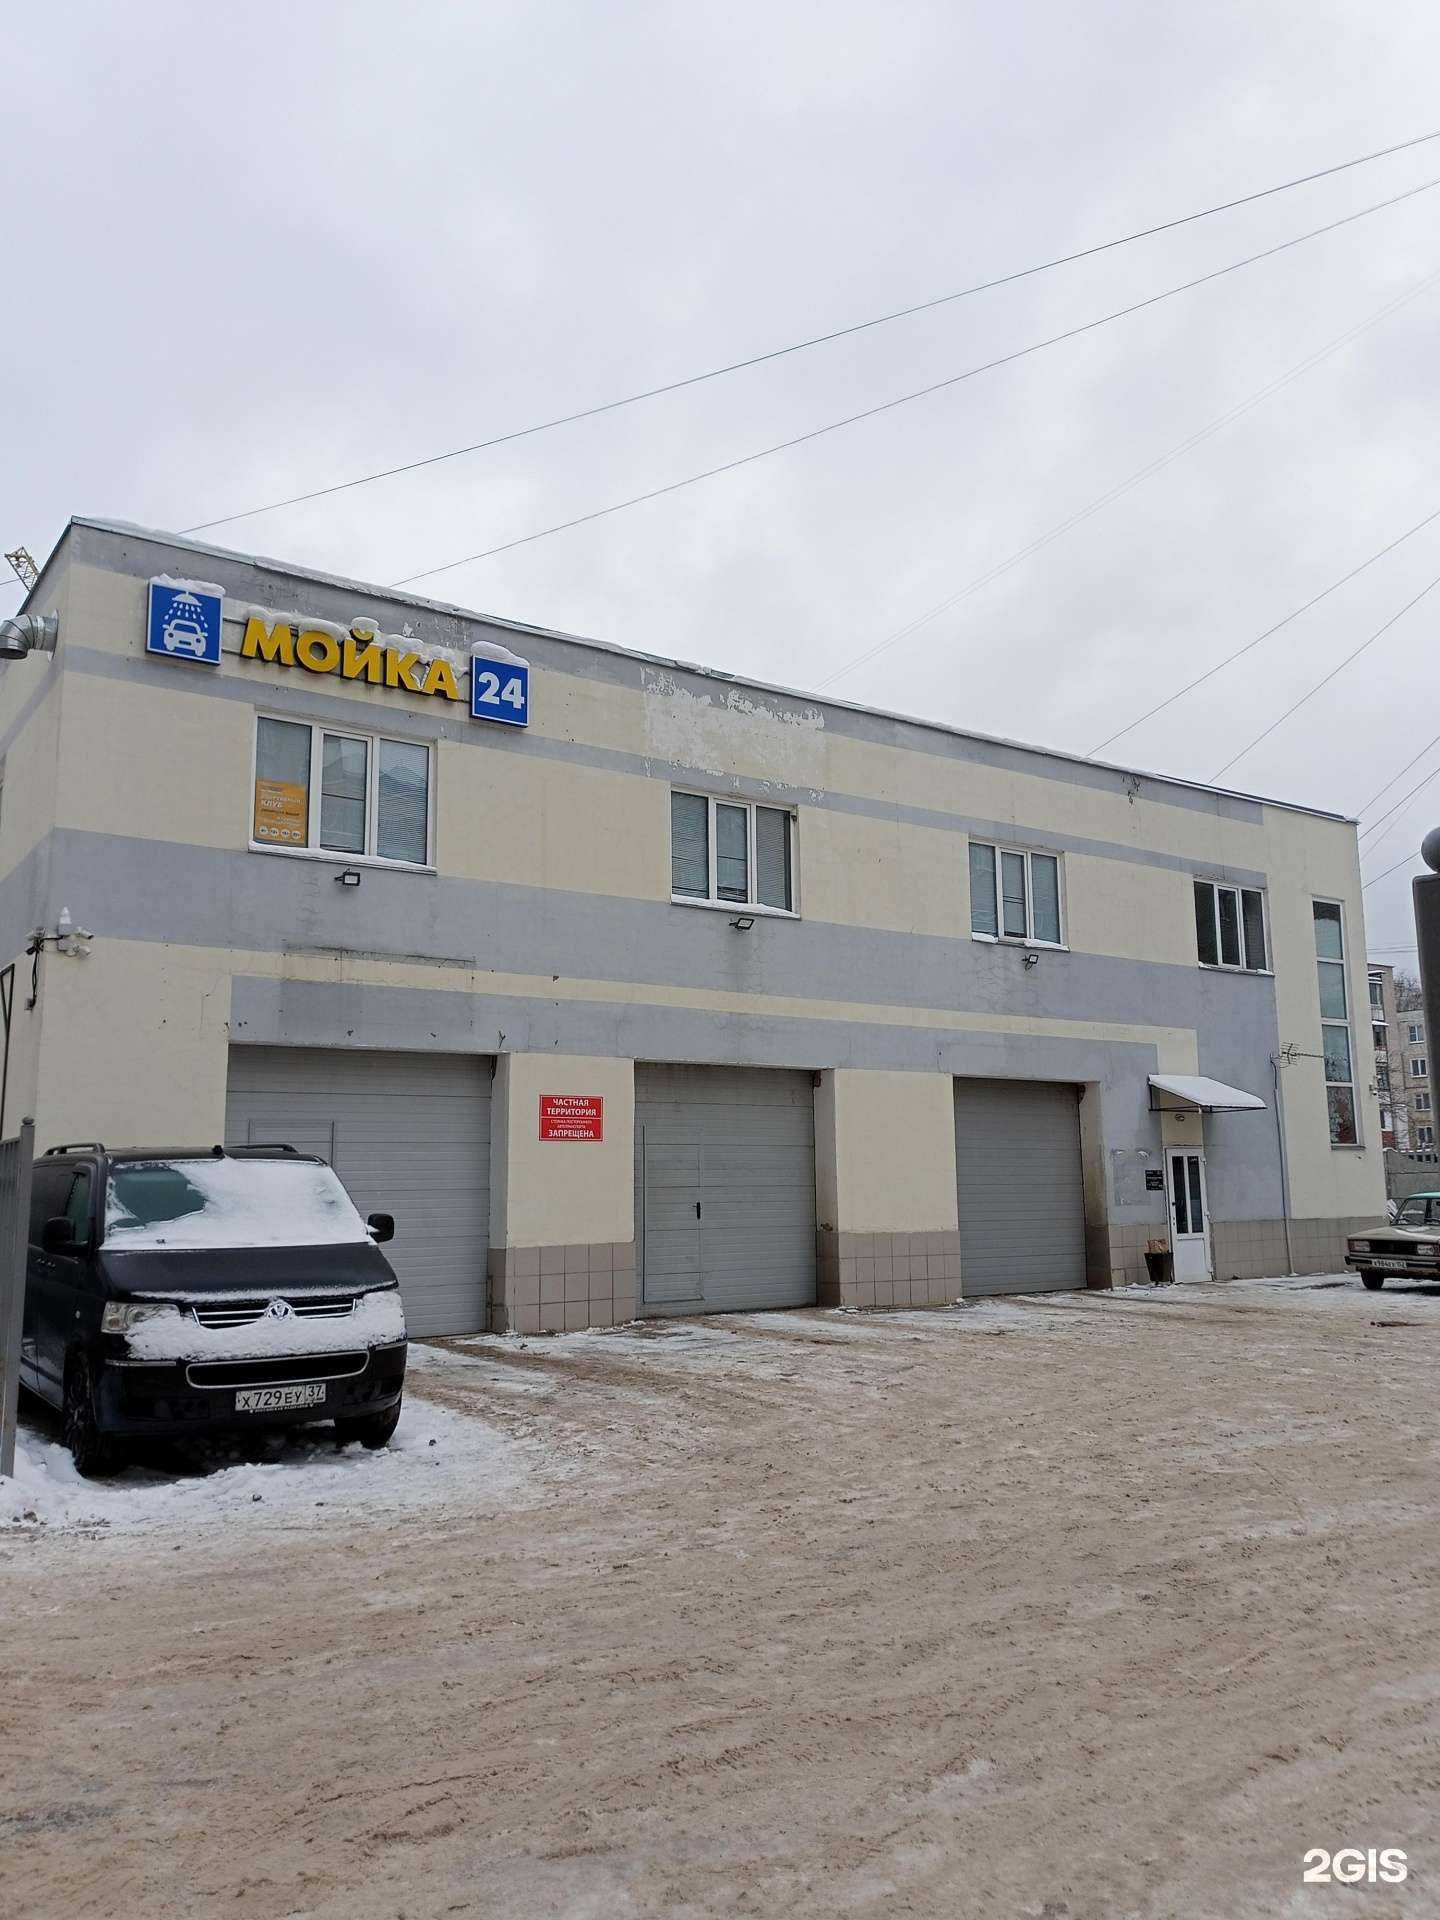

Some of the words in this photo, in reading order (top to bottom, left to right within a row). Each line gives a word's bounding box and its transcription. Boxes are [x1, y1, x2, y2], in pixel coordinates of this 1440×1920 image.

[241, 617, 459, 701] МОЙКА
[477, 671, 525, 710] 24
[552, 1098, 589, 1107] ЧАСТНАЯ
[546, 1107, 597, 1116] ТЕРРИТОРИЯ
[548, 1129, 595, 1139] ЗАПРЕЩЕНА
